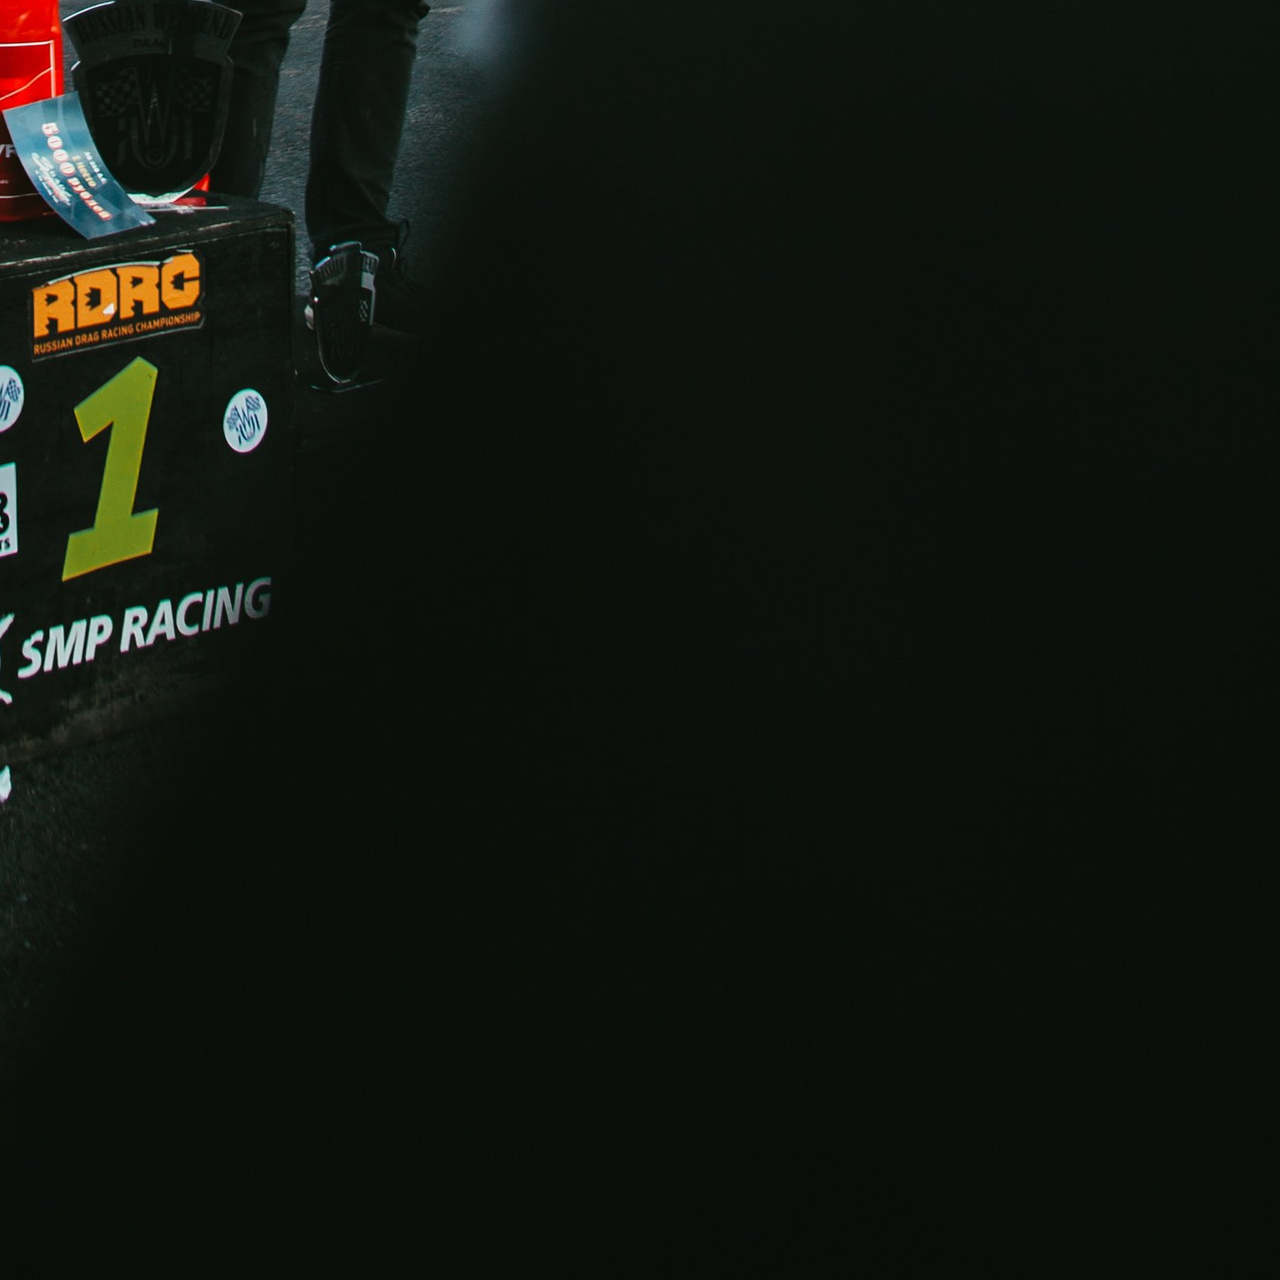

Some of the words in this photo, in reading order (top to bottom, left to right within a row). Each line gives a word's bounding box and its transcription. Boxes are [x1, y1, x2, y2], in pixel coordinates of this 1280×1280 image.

[41, 122, 77, 178] 5000
[32, 252, 201, 340] RDRC
[33, 337, 73, 357] RUSSIAN
[74, 330, 100, 347] DRAG
[101, 324, 134, 342] RACING
[135, 311, 202, 333] CHAMPIONSHIP
[61, 355, 159, 582] 1
[17, 613, 114, 680] SMP
[119, 576, 273, 654] RACING
